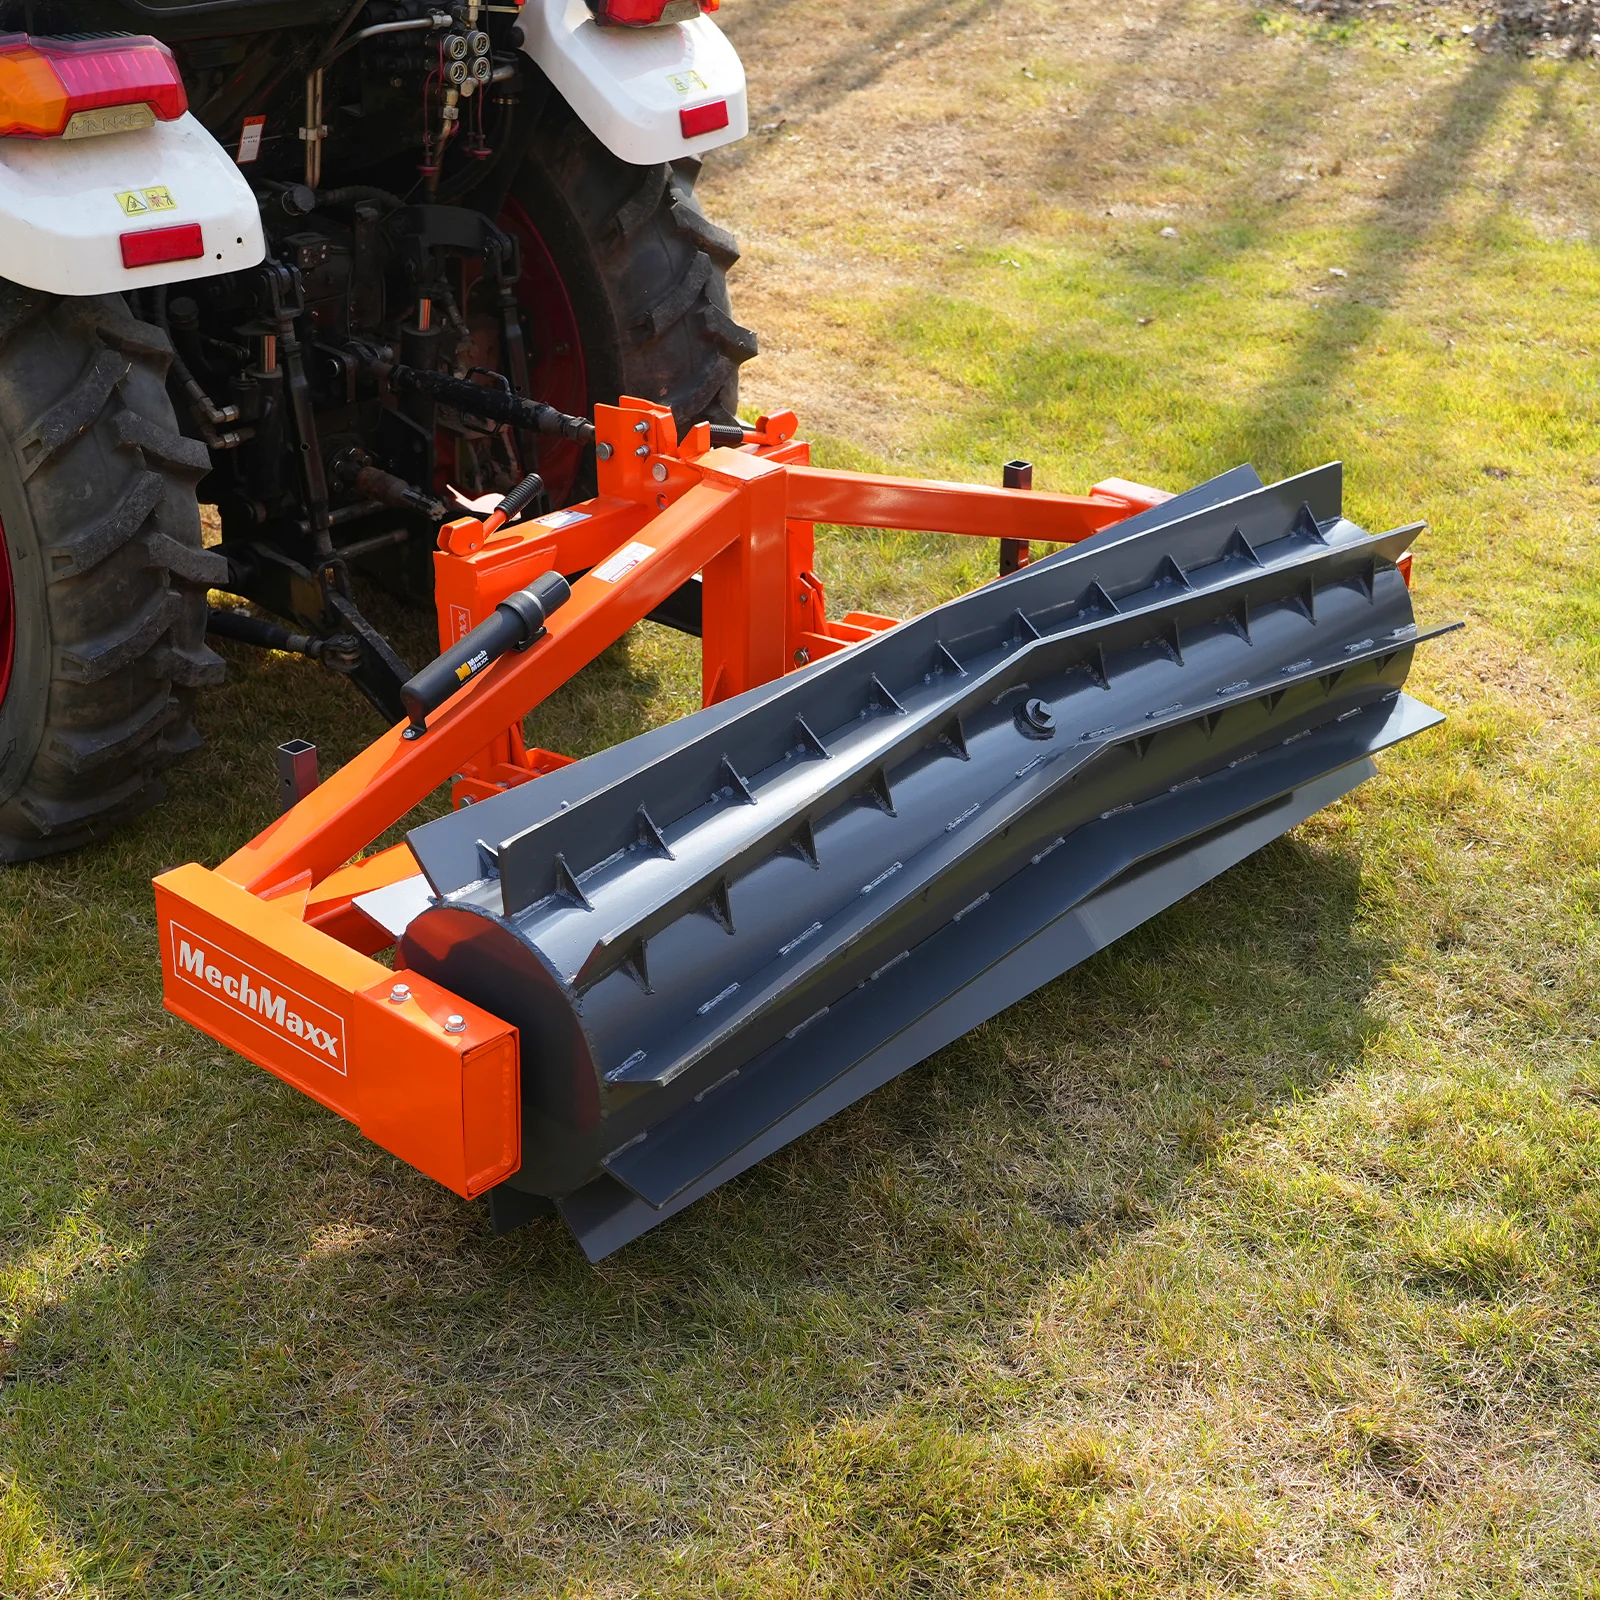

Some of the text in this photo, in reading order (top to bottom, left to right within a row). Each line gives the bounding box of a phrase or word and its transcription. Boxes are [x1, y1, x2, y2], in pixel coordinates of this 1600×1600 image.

[467, 649, 488, 667] Mech
[470, 656, 490, 673] Maxx
[178, 939, 339, 1059] MechMaxx
